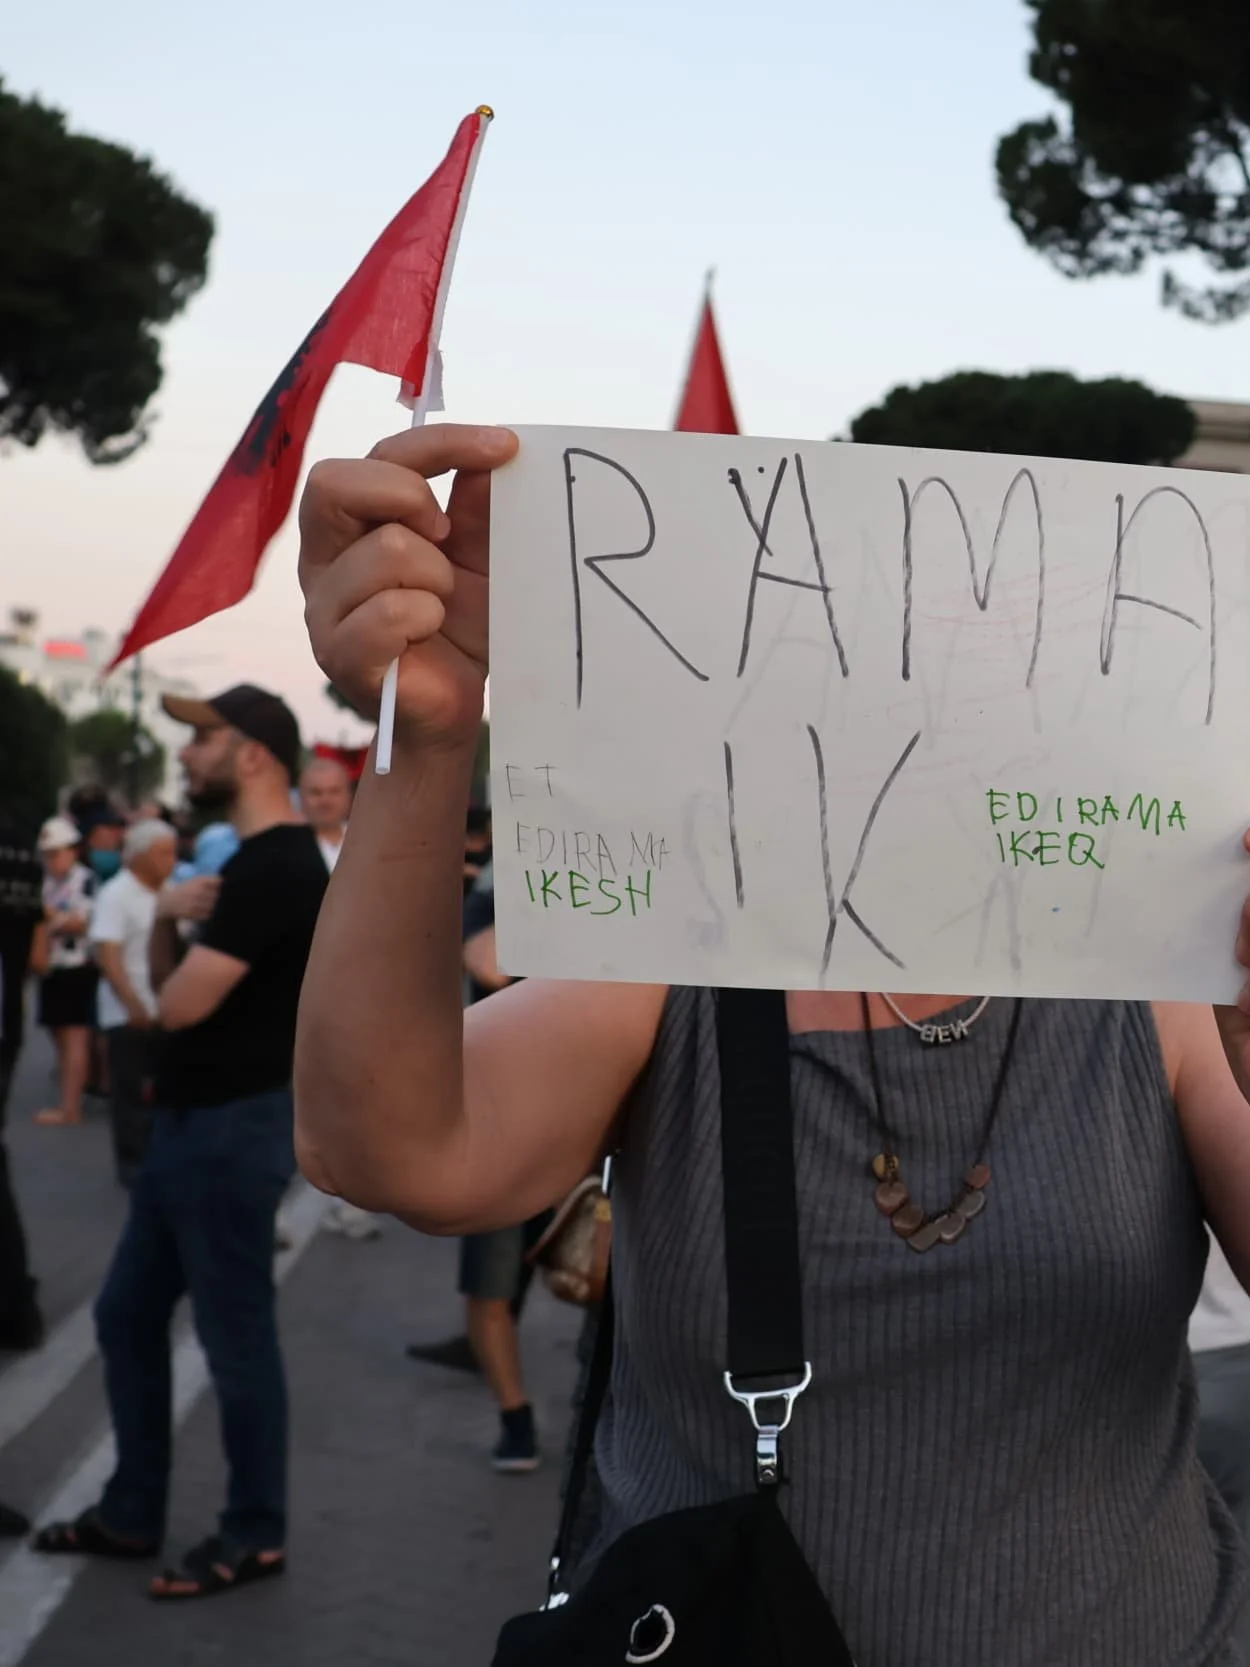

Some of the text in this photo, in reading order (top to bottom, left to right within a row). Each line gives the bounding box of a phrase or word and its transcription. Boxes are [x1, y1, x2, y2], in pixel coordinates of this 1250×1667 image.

[505, 763, 558, 803] ET
[996, 830, 1105, 869] IKEQ
[524, 868, 652, 917] IKESH
